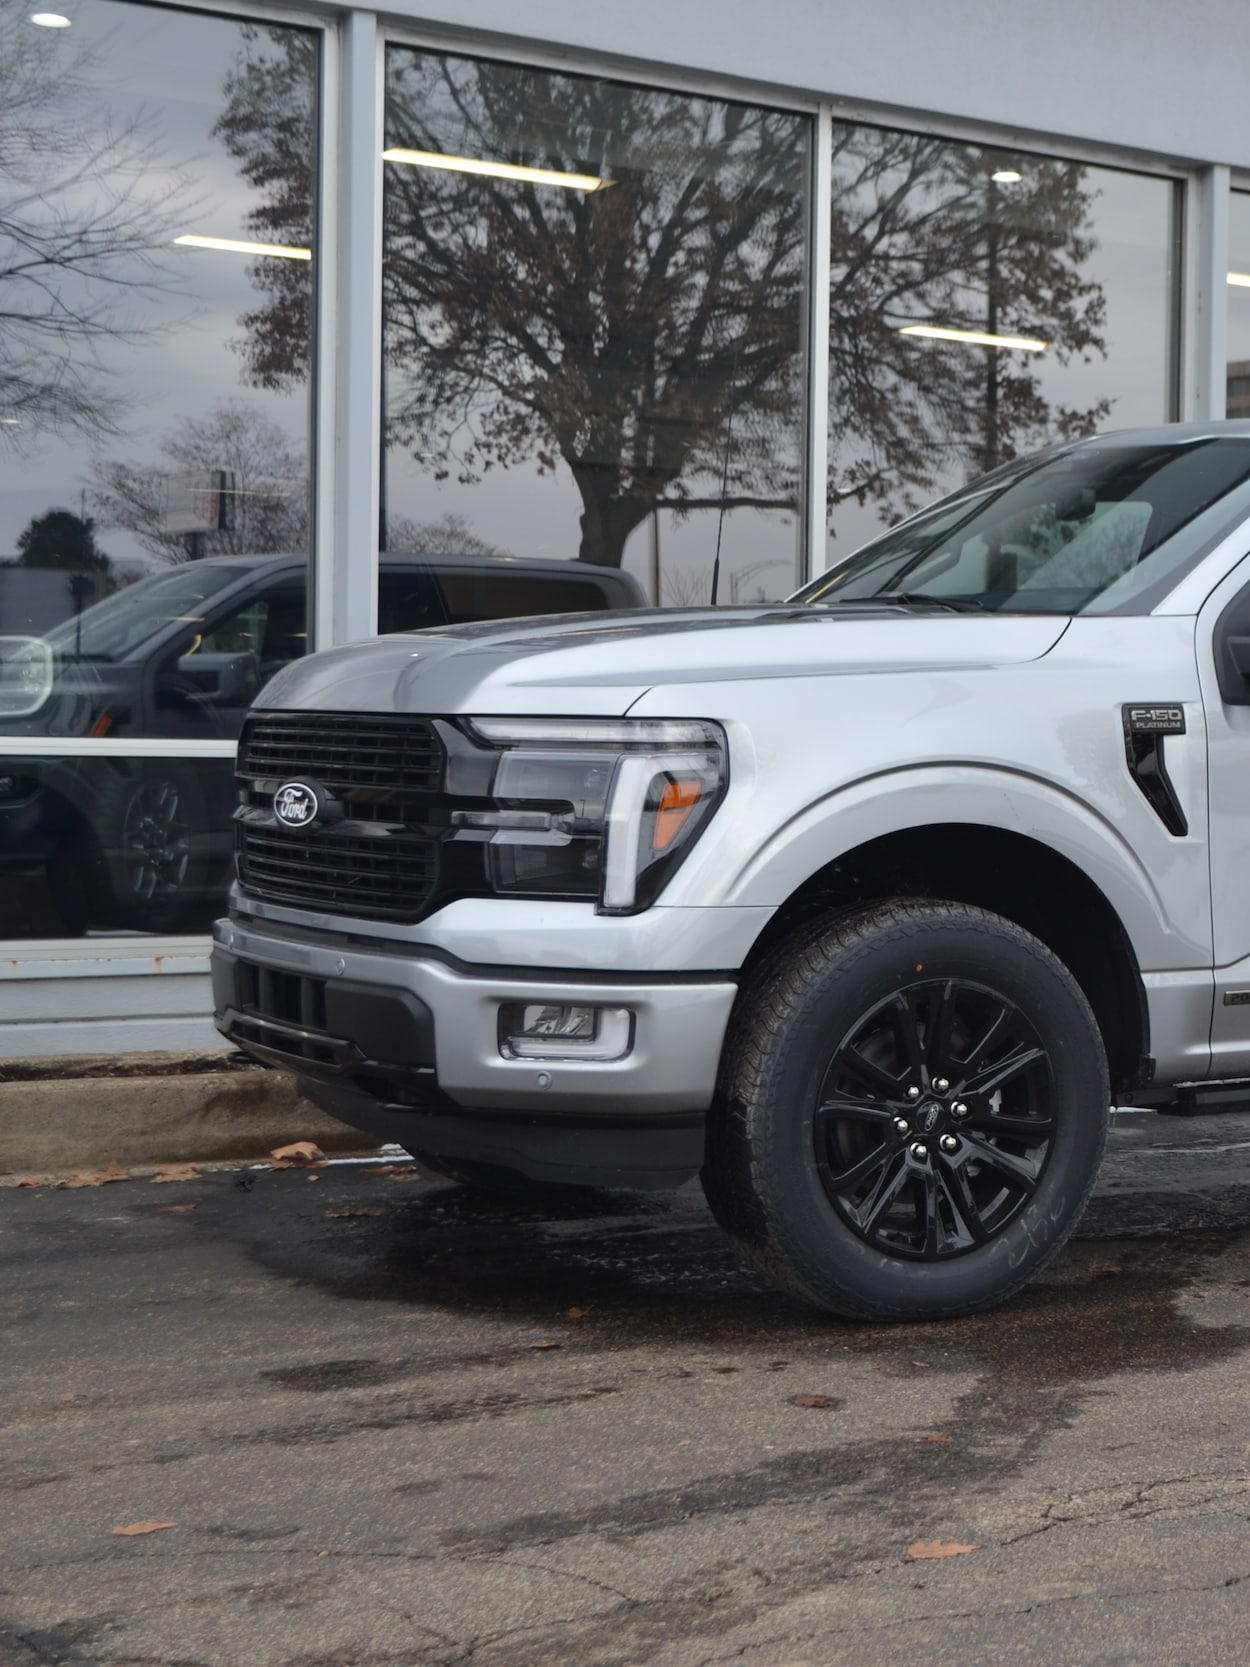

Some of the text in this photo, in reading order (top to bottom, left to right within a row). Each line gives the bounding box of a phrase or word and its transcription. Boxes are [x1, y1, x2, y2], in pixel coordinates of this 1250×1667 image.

[1131, 709, 1182, 721] F-150
[1136, 721, 1181, 729] PLATINUM
[280, 788, 309, 819] Ford
